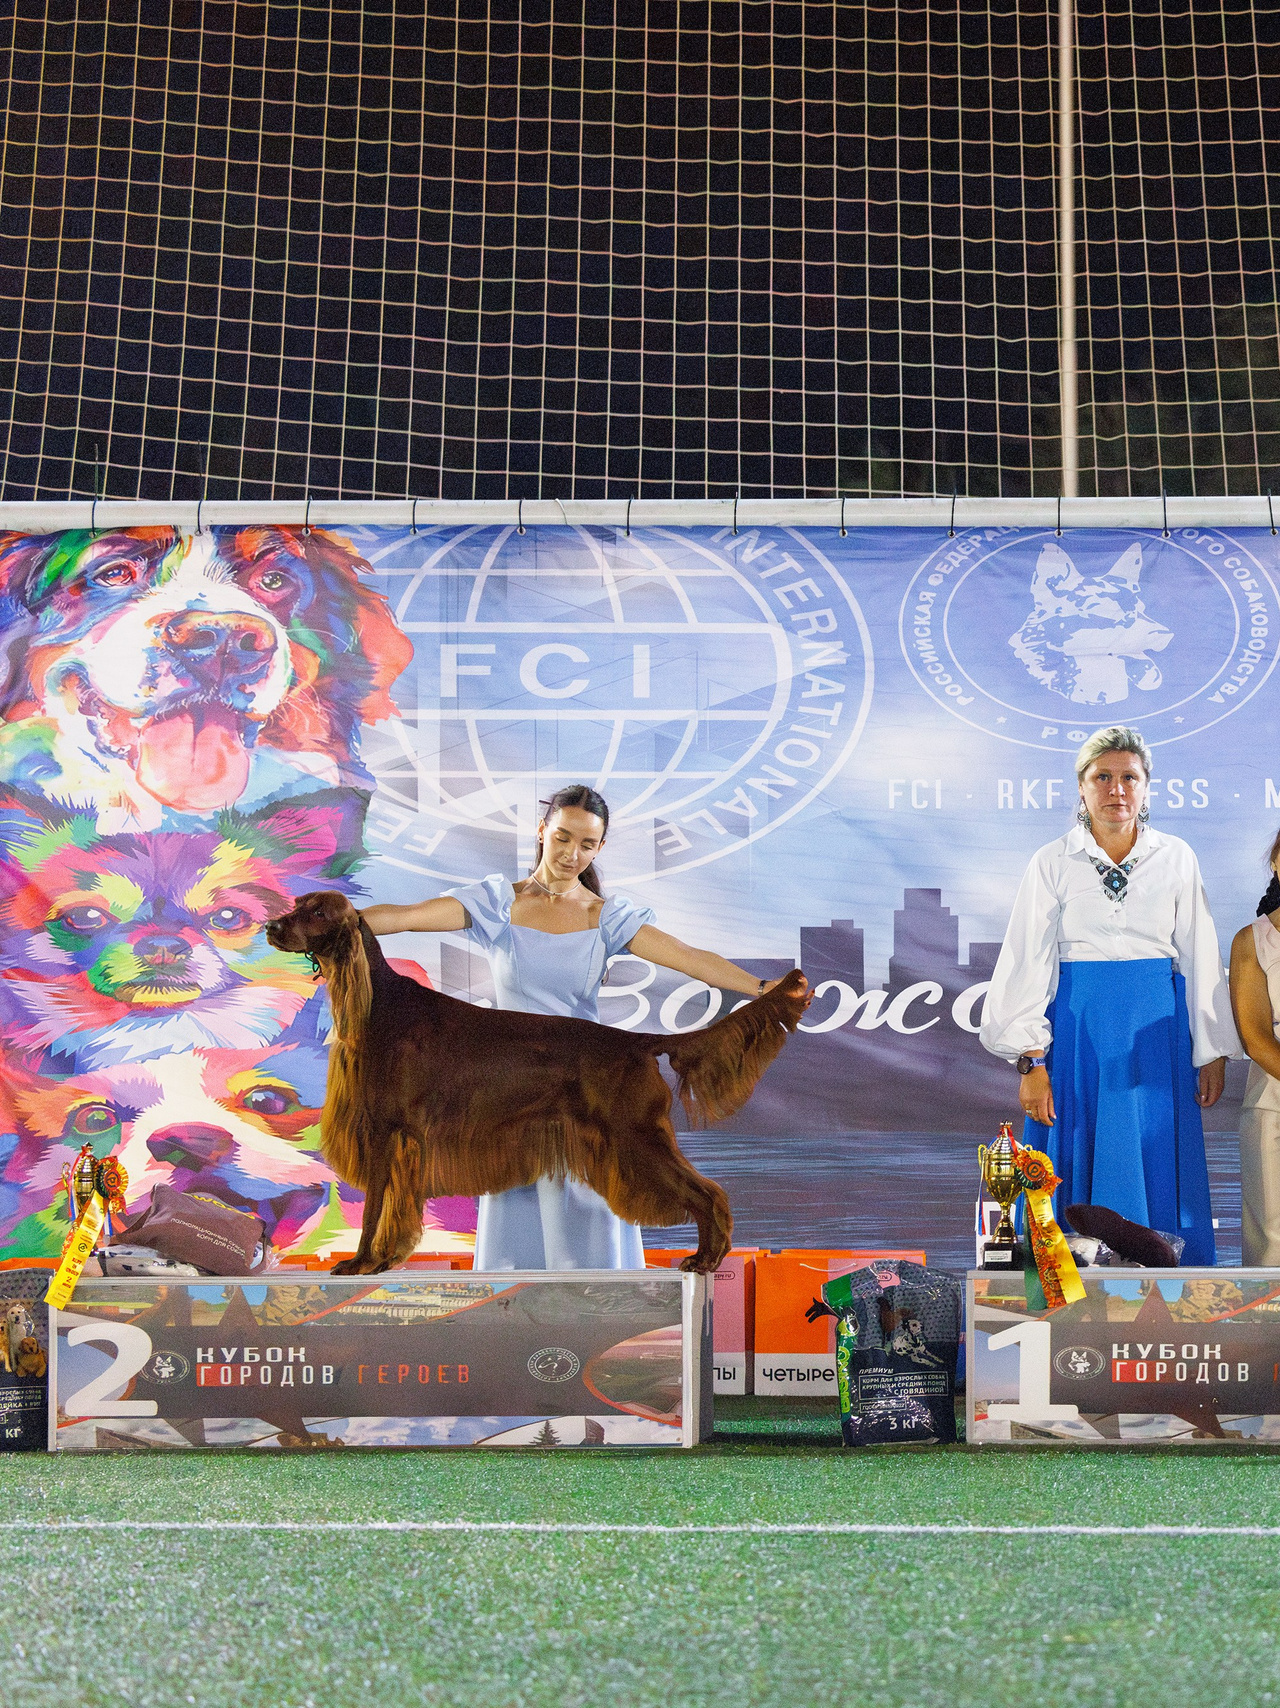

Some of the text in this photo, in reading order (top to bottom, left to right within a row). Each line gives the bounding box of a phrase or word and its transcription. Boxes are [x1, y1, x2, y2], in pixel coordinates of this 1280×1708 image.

[1207, 556, 1269, 704] СОБАКОВОДСТВА
[912, 590, 975, 706] РОССИЙСКАЯ
[440, 643, 651, 699] FCI
[888, 779, 942, 809] FCI
[997, 779, 1064, 809] RKF
[1149, 778, 1209, 809] FSS
[196, 1347, 306, 1363] КУБОК
[1112, 1344, 1221, 1360] КУБОК
[65, 1322, 158, 1416] 2
[200, 1365, 335, 1387] ГОРОДОВ
[358, 1364, 470, 1384] ГЕРОЕВ
[762, 1367, 835, 1382] четыре
[987, 1321, 1079, 1421] 1
[1116, 1362, 1250, 1385] ГОРОДОВ
[889, 1417, 898, 1430] 3
